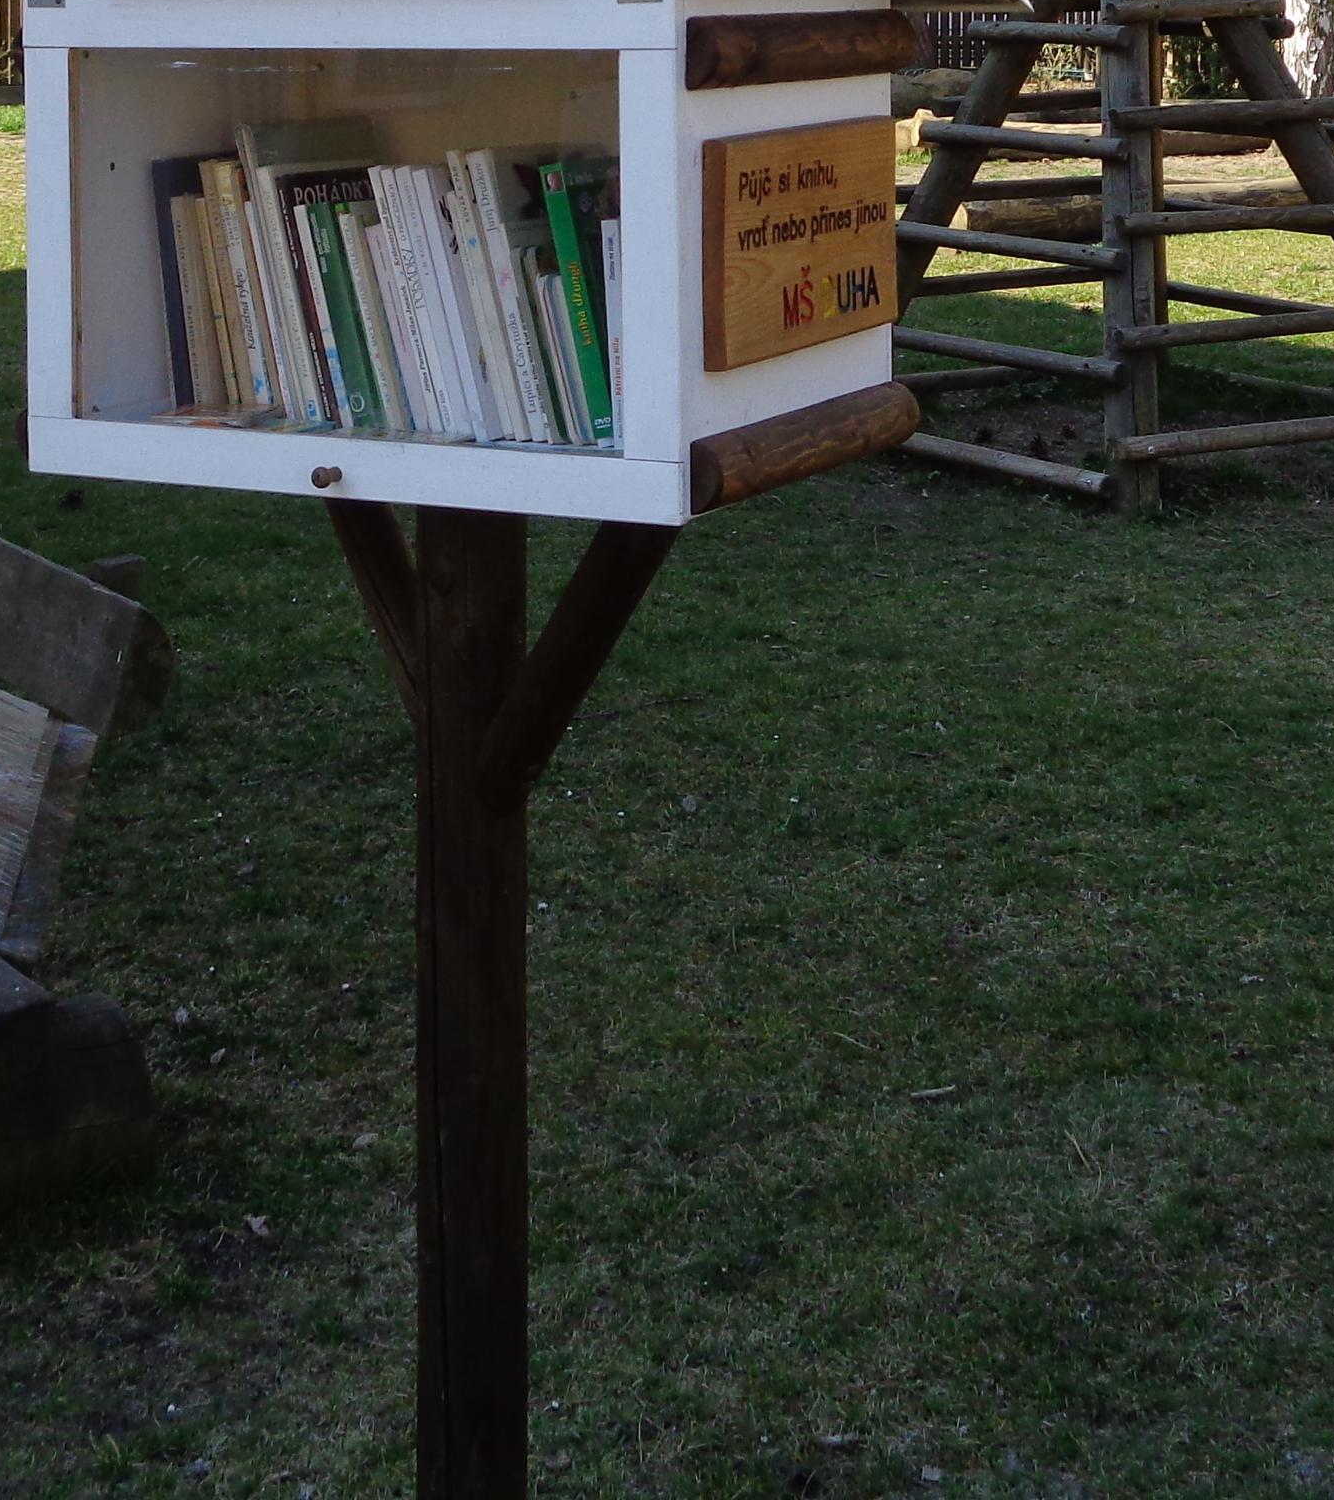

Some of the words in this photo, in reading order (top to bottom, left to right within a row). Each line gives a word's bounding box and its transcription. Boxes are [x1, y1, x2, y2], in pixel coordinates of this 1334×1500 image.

[738, 167, 771, 206] Půjč
[778, 164, 791, 193] si
[798, 159, 838, 191] knihu,
[738, 214, 770, 251] vrať
[772, 212, 807, 244] nebo
[810, 204, 852, 244] přines
[854, 199, 887, 234] jinou
[783, 264, 815, 330] MŠ
